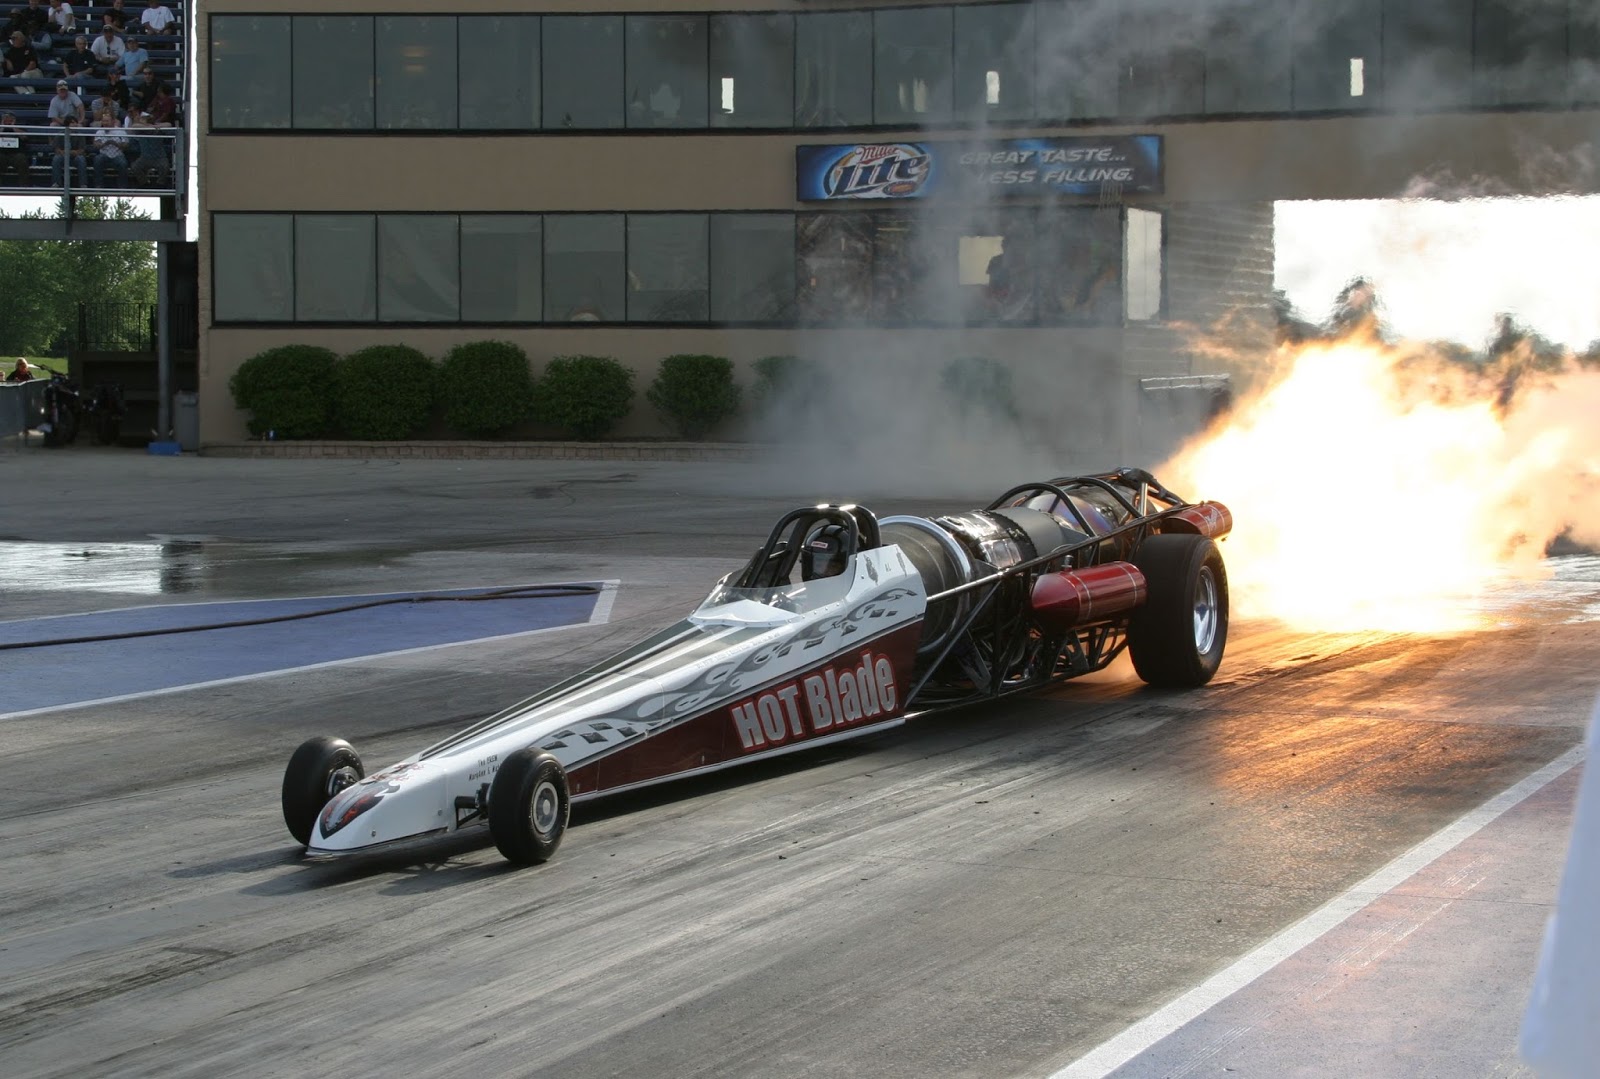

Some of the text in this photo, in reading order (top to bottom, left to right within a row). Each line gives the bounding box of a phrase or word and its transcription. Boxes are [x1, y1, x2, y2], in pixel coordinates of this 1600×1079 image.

[857, 144, 898, 161] Miller
[959, 147, 1126, 165] GREAT TASTE...
[828, 153, 930, 197] Lite
[977, 167, 1134, 185] LESS FILLING.
[731, 652, 896, 749] HOT Blade
